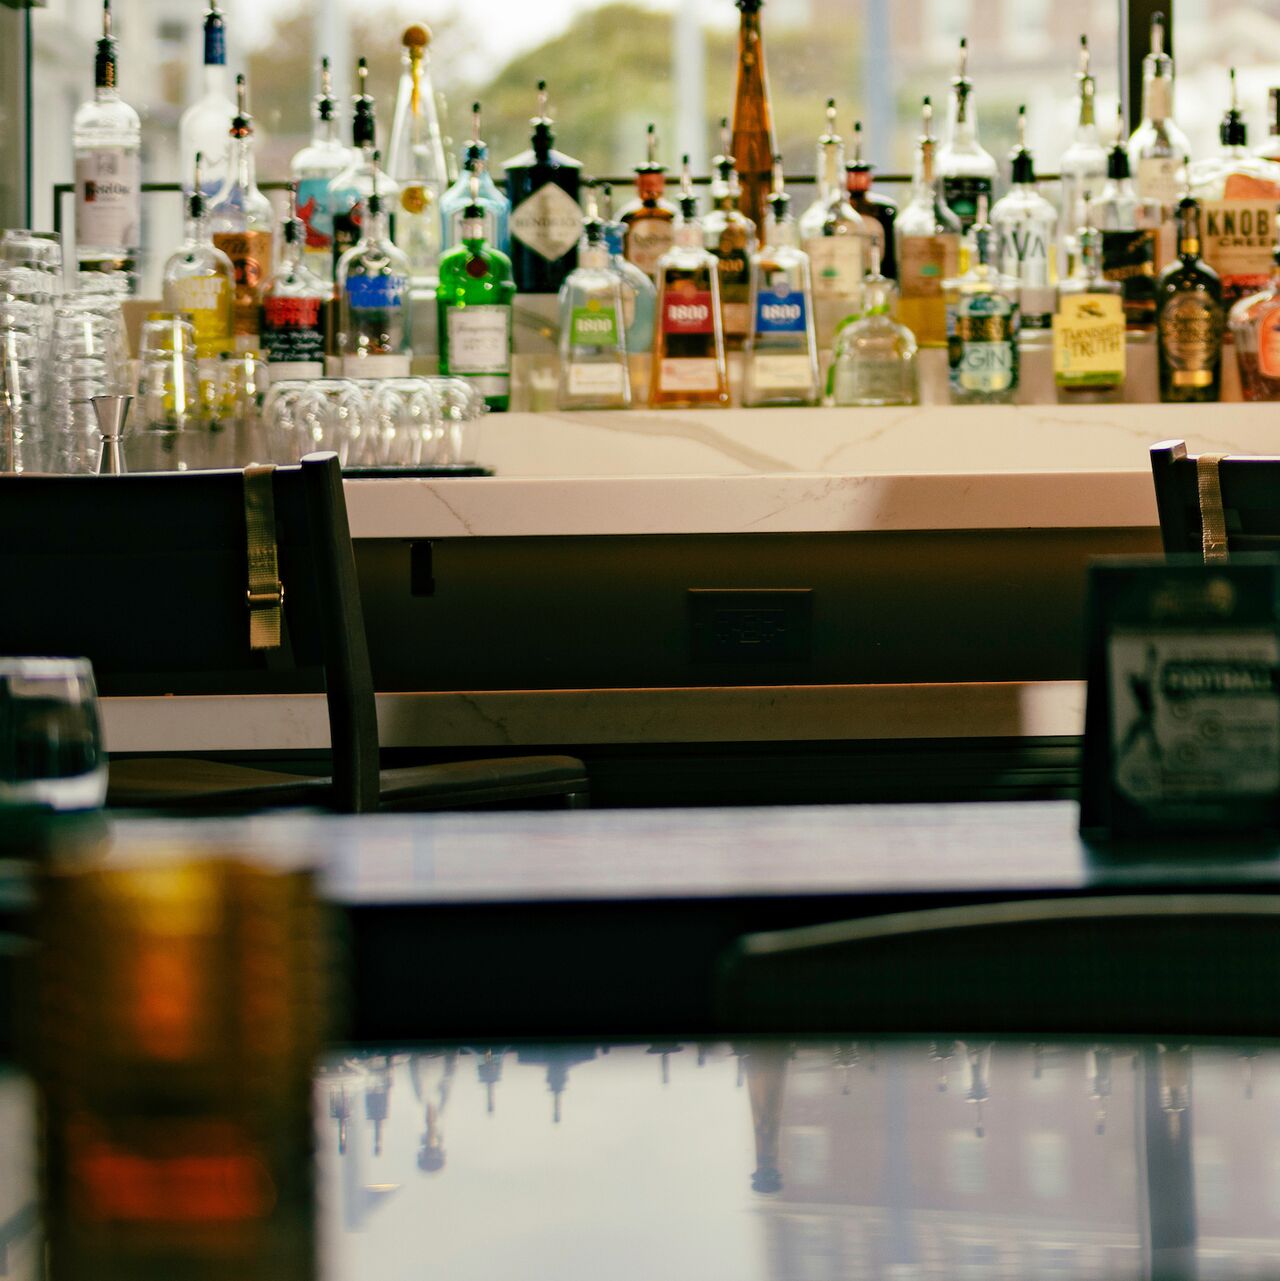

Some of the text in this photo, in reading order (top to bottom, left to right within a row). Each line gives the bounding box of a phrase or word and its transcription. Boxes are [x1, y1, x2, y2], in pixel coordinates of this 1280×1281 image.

[1206, 209, 1270, 236] KNOB
[668, 303, 709, 321] 1800
[761, 303, 801, 321] 1800
[575, 318, 613, 333] 1800
[1072, 337, 1121, 358] TRUTH
[966, 347, 1006, 368] GIN
